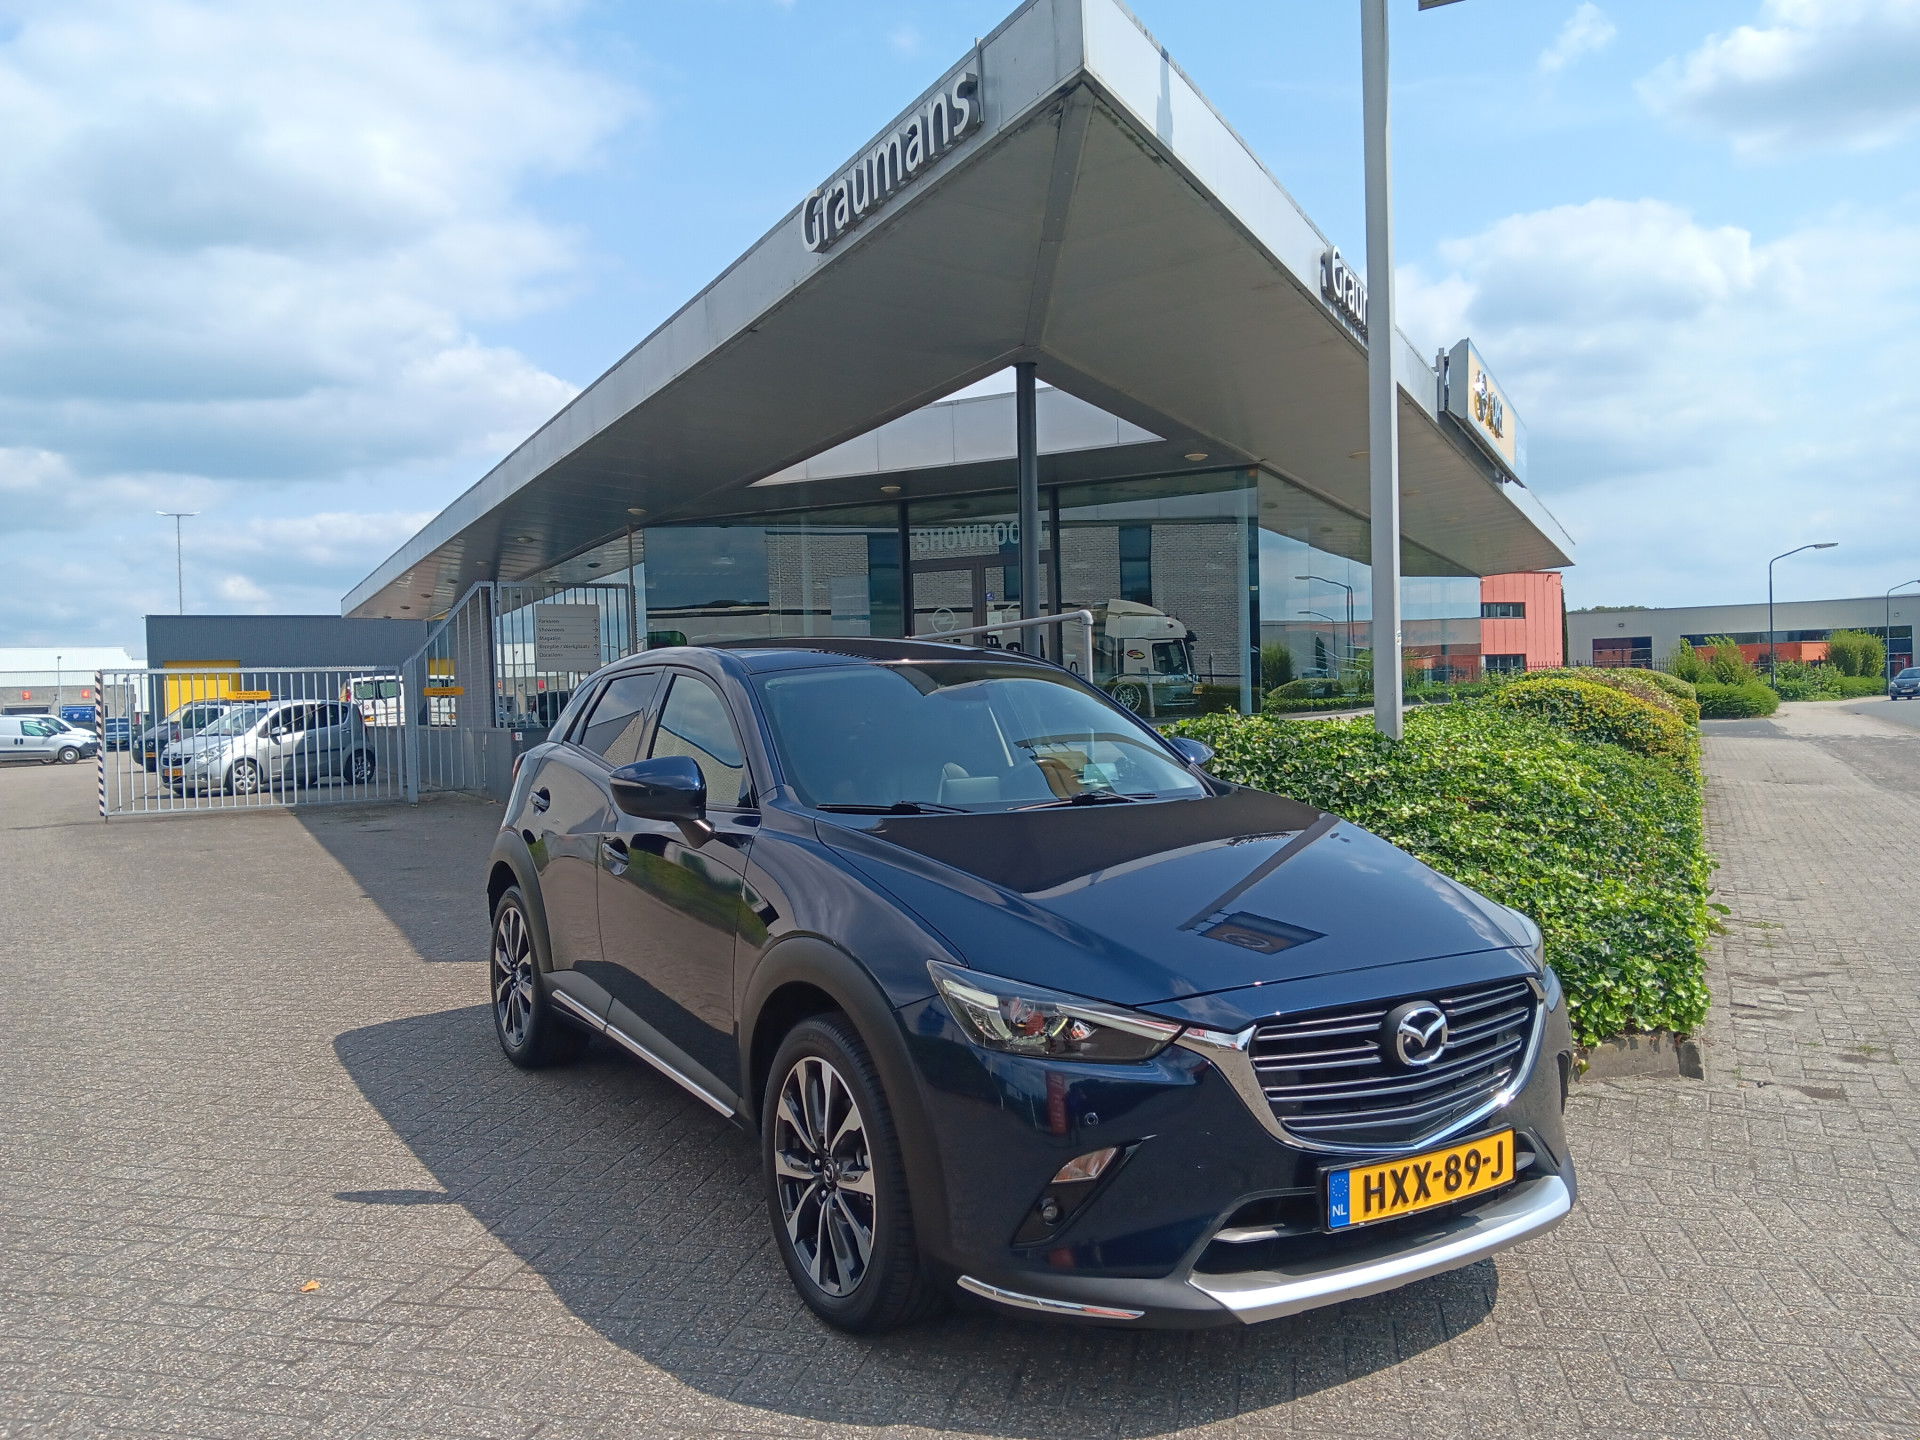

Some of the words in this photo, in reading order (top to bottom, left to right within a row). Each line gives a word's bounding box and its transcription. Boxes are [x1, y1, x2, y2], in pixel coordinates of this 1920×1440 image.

[802, 72, 977, 253] Graumans
[916, 520, 1020, 551] SHOWROO
[1364, 1140, 1504, 1213] HXX-89-J
[1332, 1203, 1347, 1217] NL
